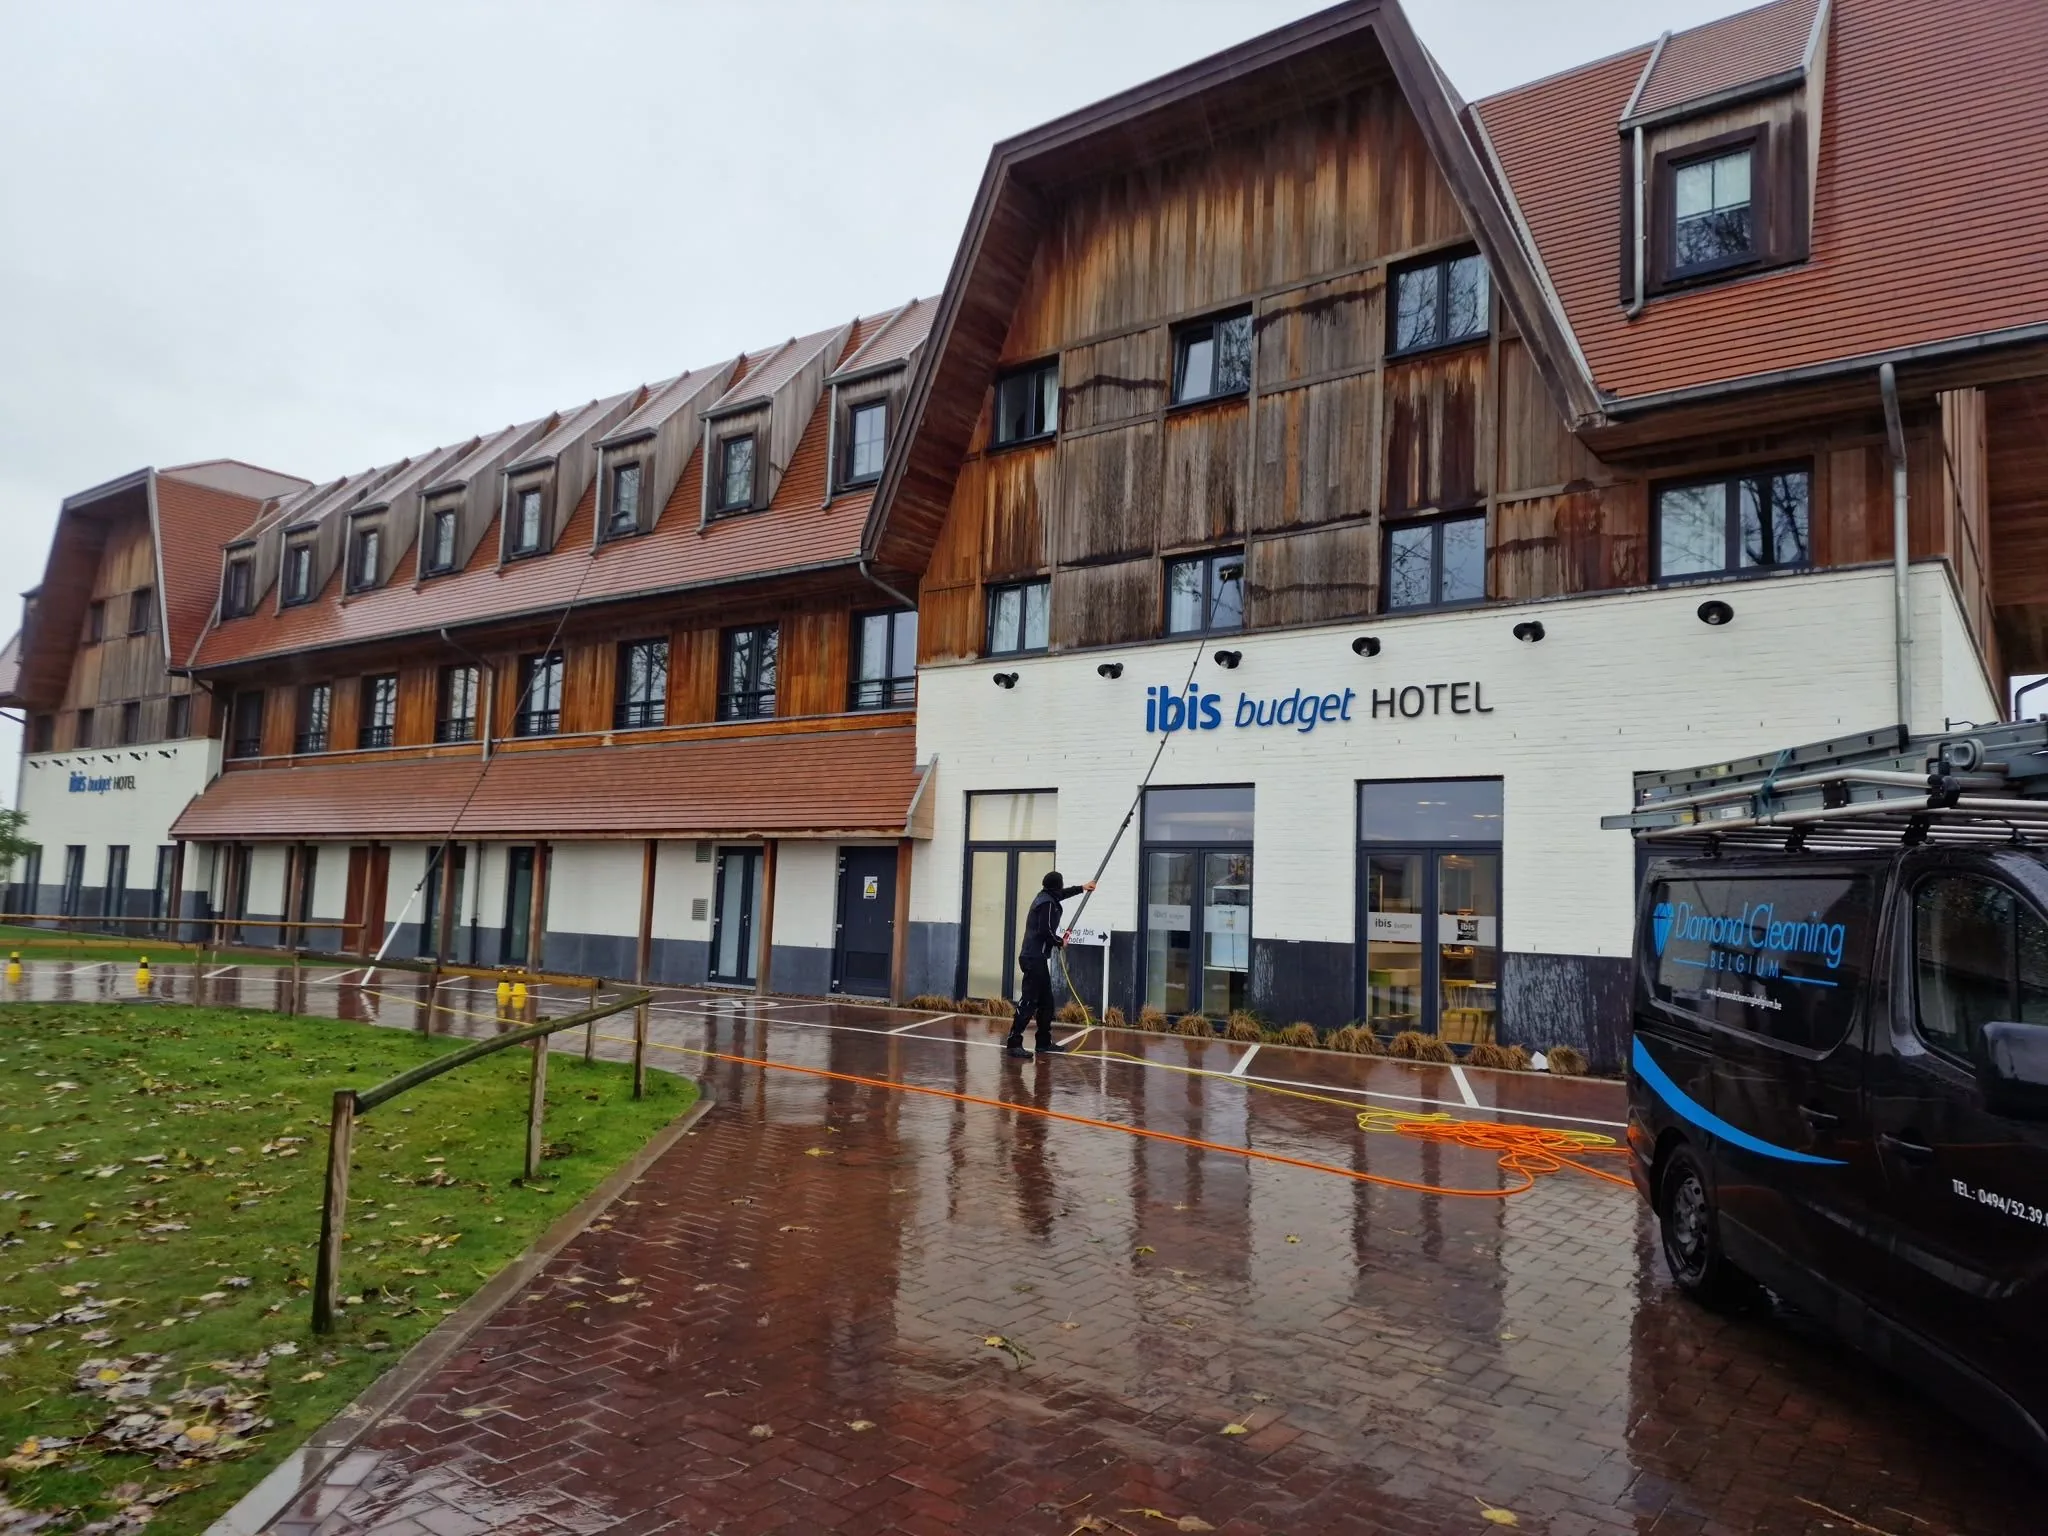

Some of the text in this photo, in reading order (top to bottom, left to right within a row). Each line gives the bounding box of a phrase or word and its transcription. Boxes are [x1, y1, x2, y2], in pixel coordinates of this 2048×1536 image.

[1145, 681, 1494, 733] ibis budget HOTEL
[113, 775, 136, 790] HOTEL
[1375, 918, 1392, 928] ibis
[1460, 922, 1475, 931] ibis
[1675, 901, 1846, 968] Diamond Cleaning
[1710, 951, 1780, 978] BELGIUM
[1952, 1178, 1976, 1200] TEL.:
